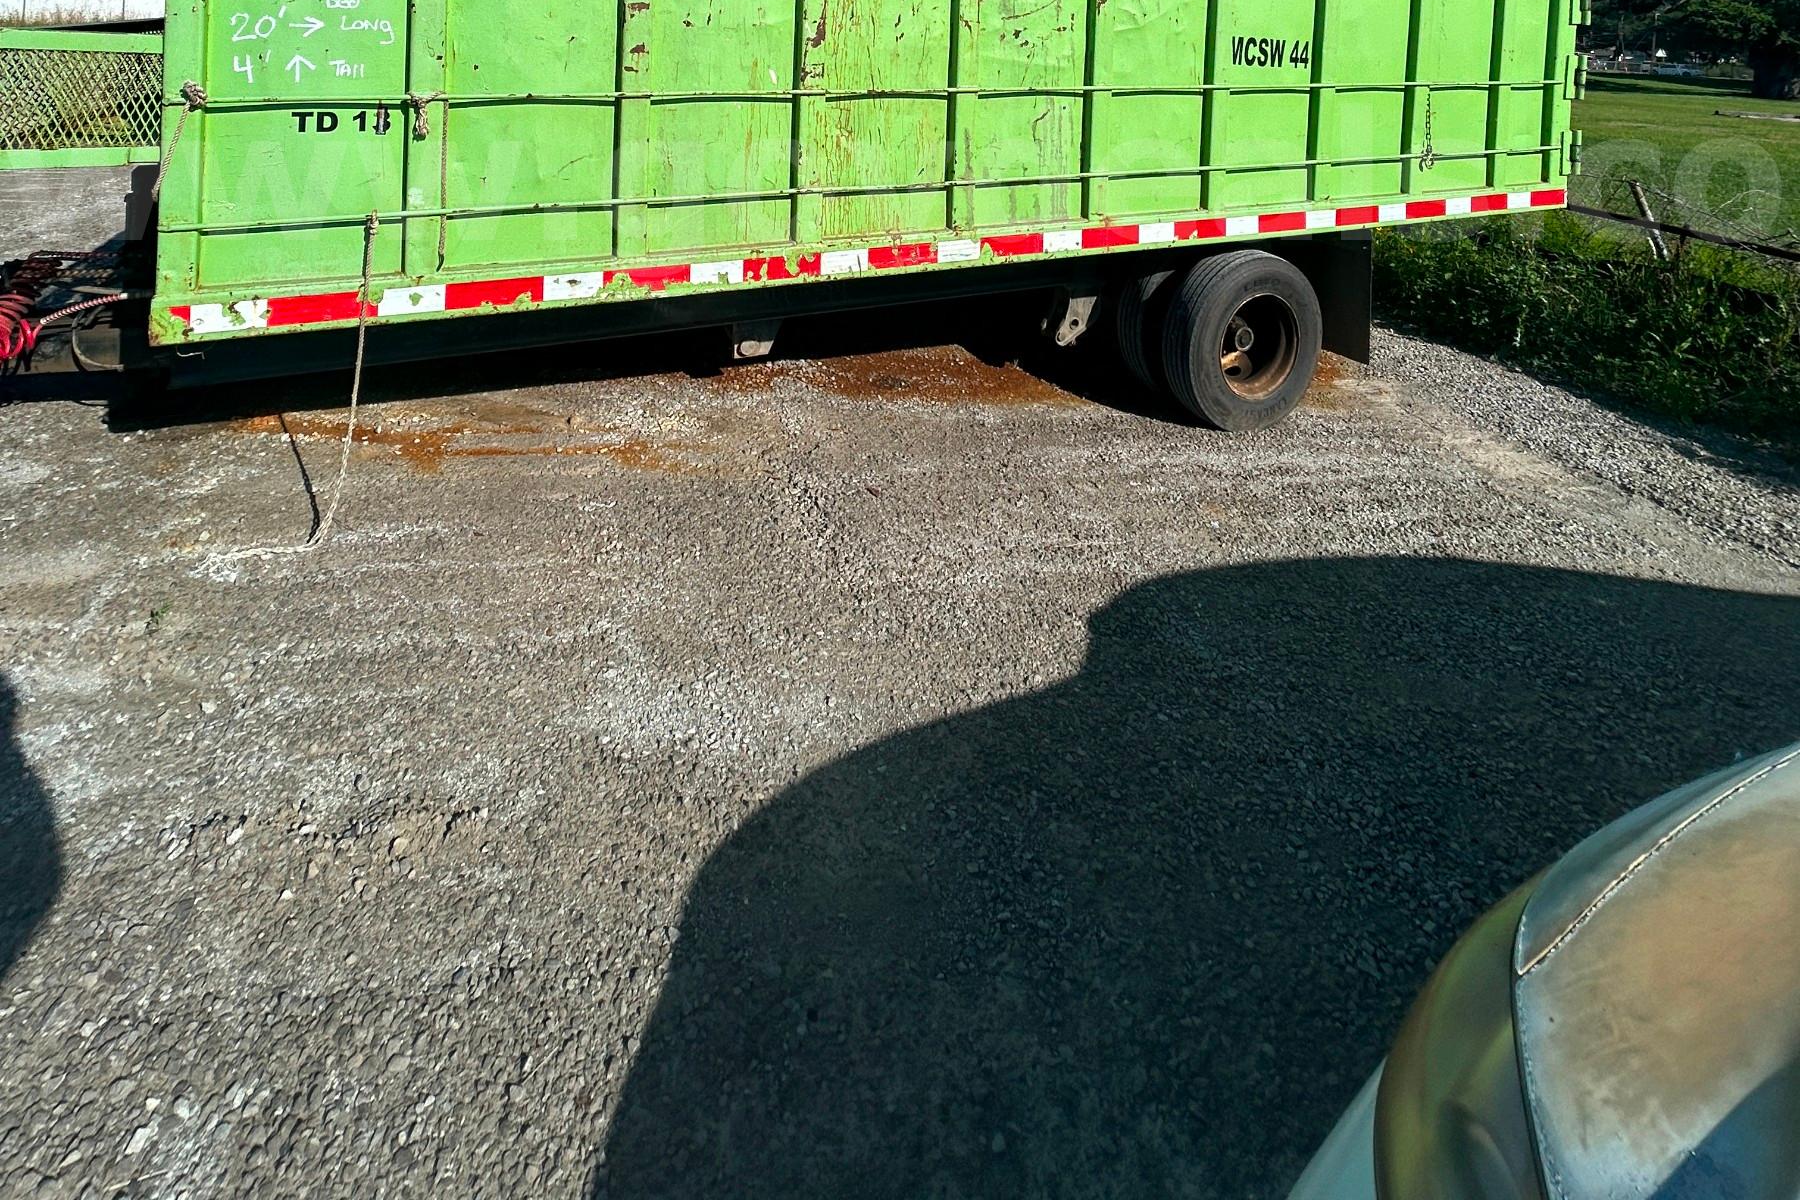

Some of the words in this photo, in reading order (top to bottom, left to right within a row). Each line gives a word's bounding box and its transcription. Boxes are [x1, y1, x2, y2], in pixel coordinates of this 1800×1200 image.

[229, 4, 287, 42] 20'
[1289, 40, 1309, 69] 44
[291, 111, 339, 133] TD
